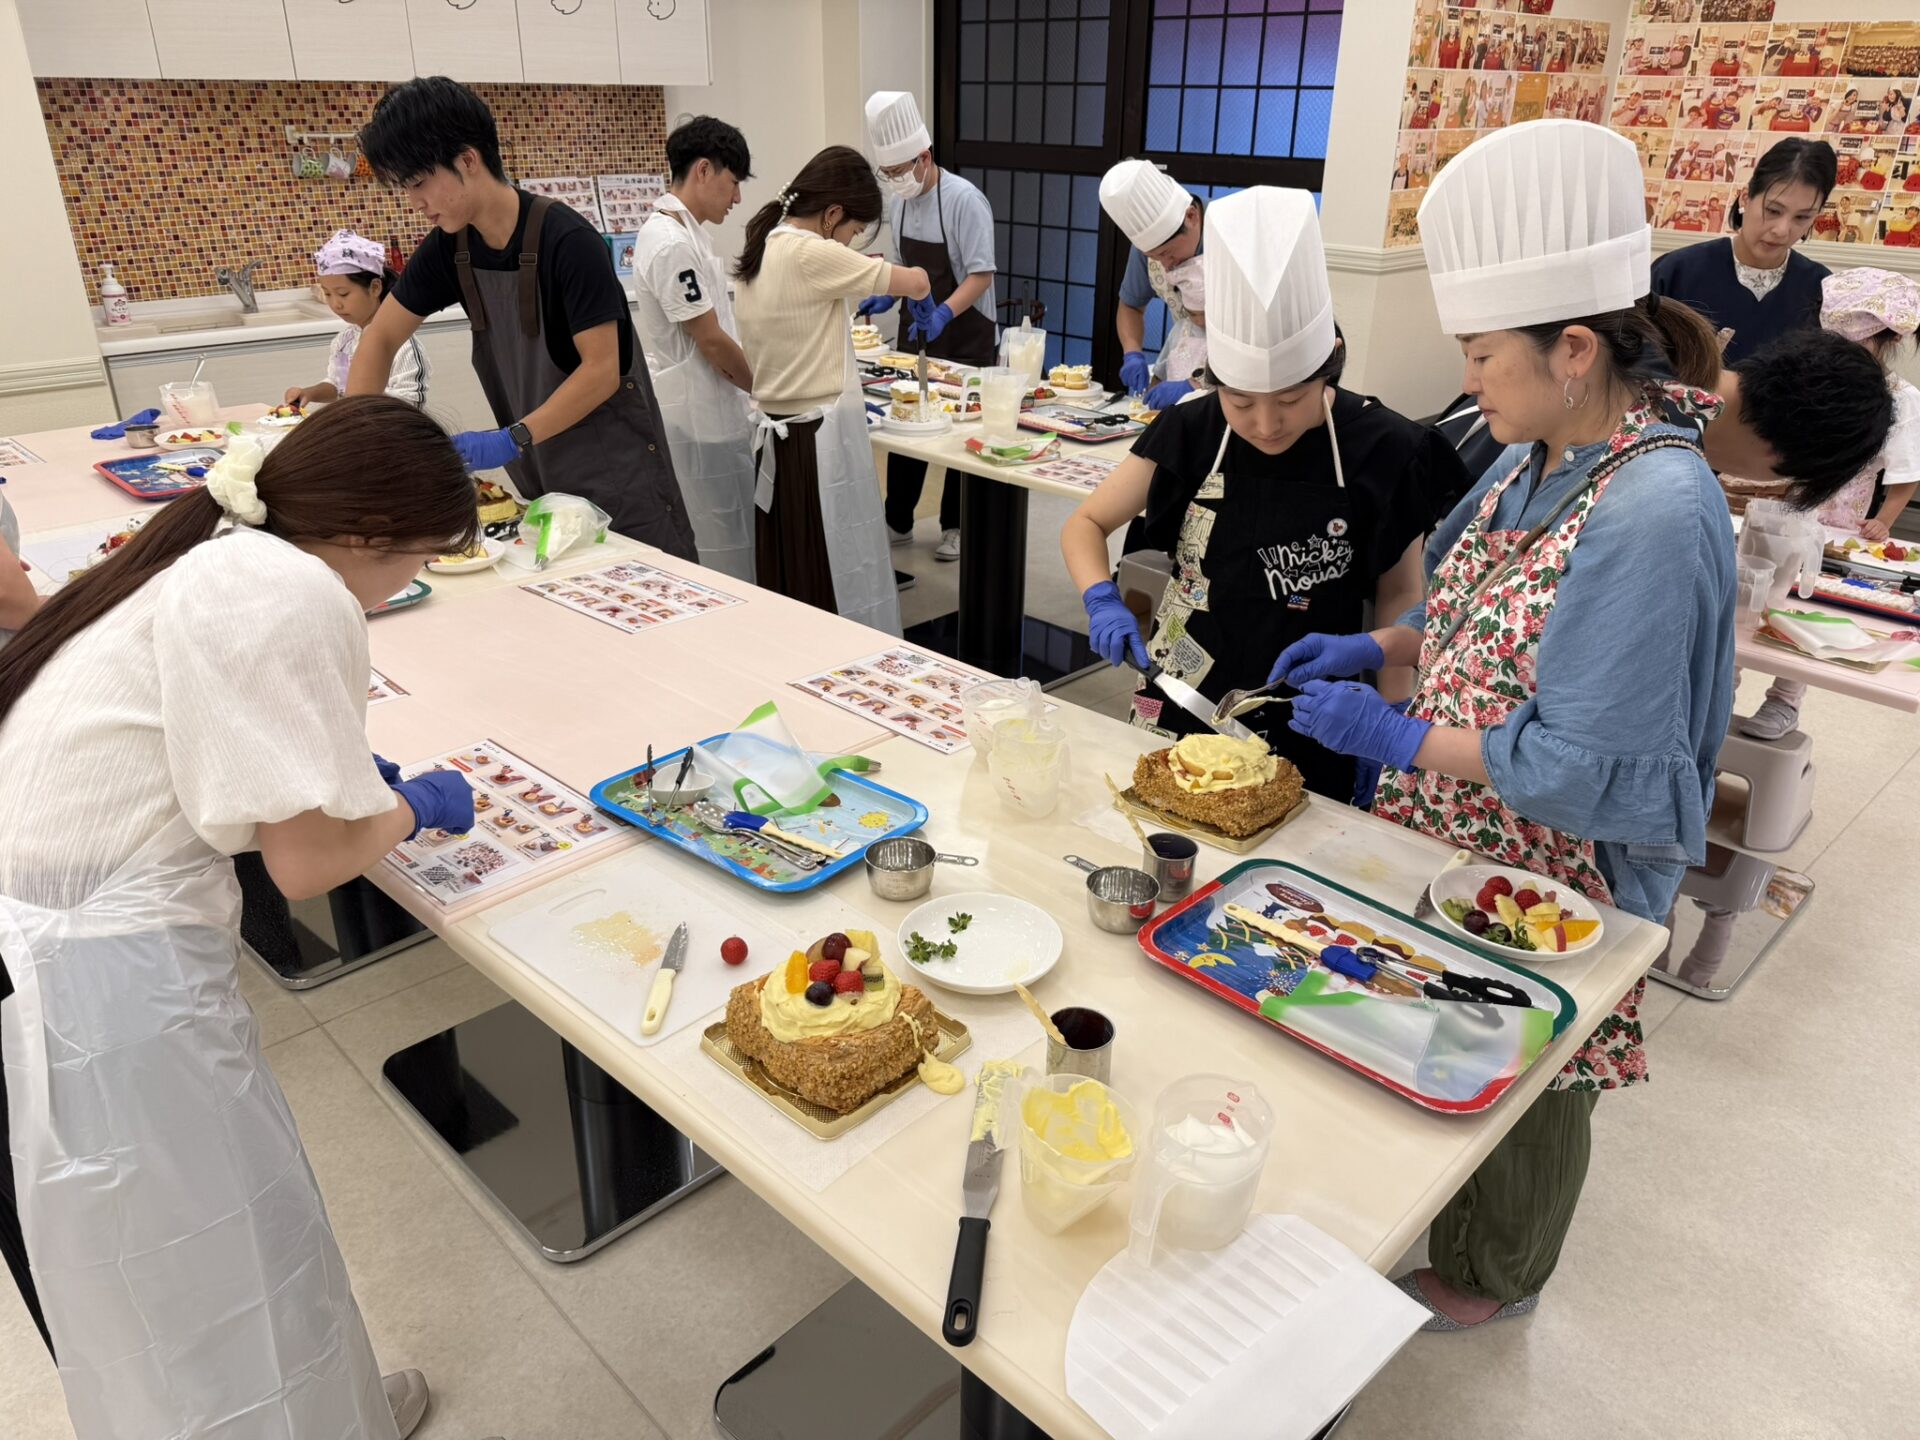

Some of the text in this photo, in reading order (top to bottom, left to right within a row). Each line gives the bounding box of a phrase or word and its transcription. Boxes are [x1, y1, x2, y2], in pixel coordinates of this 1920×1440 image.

[679, 268, 702, 303] 3
[1277, 540, 1354, 569] Mickey
[1264, 563, 1350, 600] Mouse
